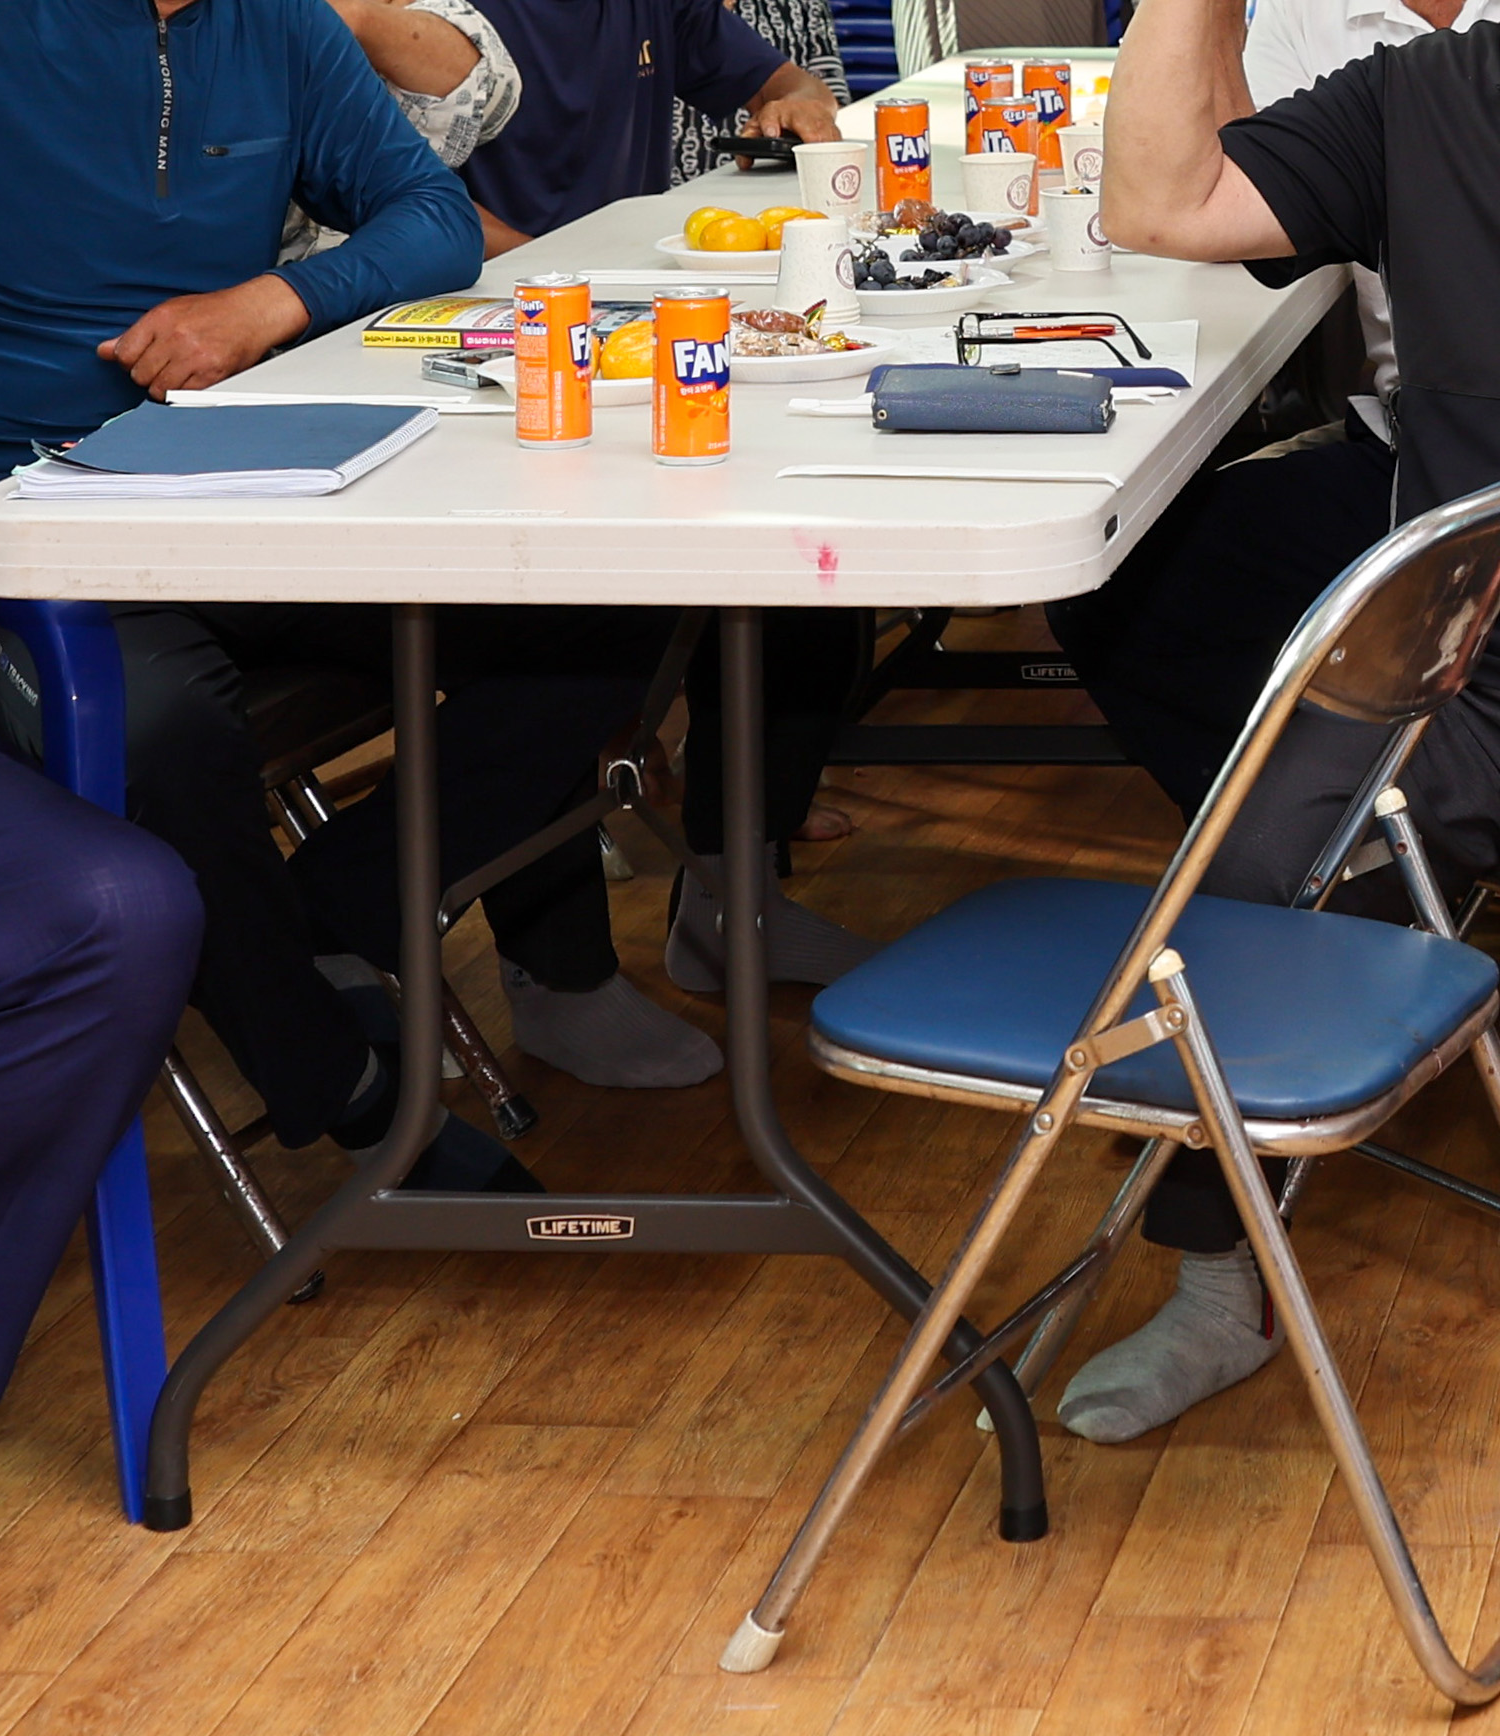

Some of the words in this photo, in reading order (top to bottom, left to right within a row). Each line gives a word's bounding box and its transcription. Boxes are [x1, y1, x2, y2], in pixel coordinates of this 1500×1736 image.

[158, 53, 173, 129] WORKING
[157, 135, 168, 171] MAN
[886, 129, 930, 164] FAN
[673, 331, 731, 379] FAN
[540, 1220, 622, 1235] LIFETIME
